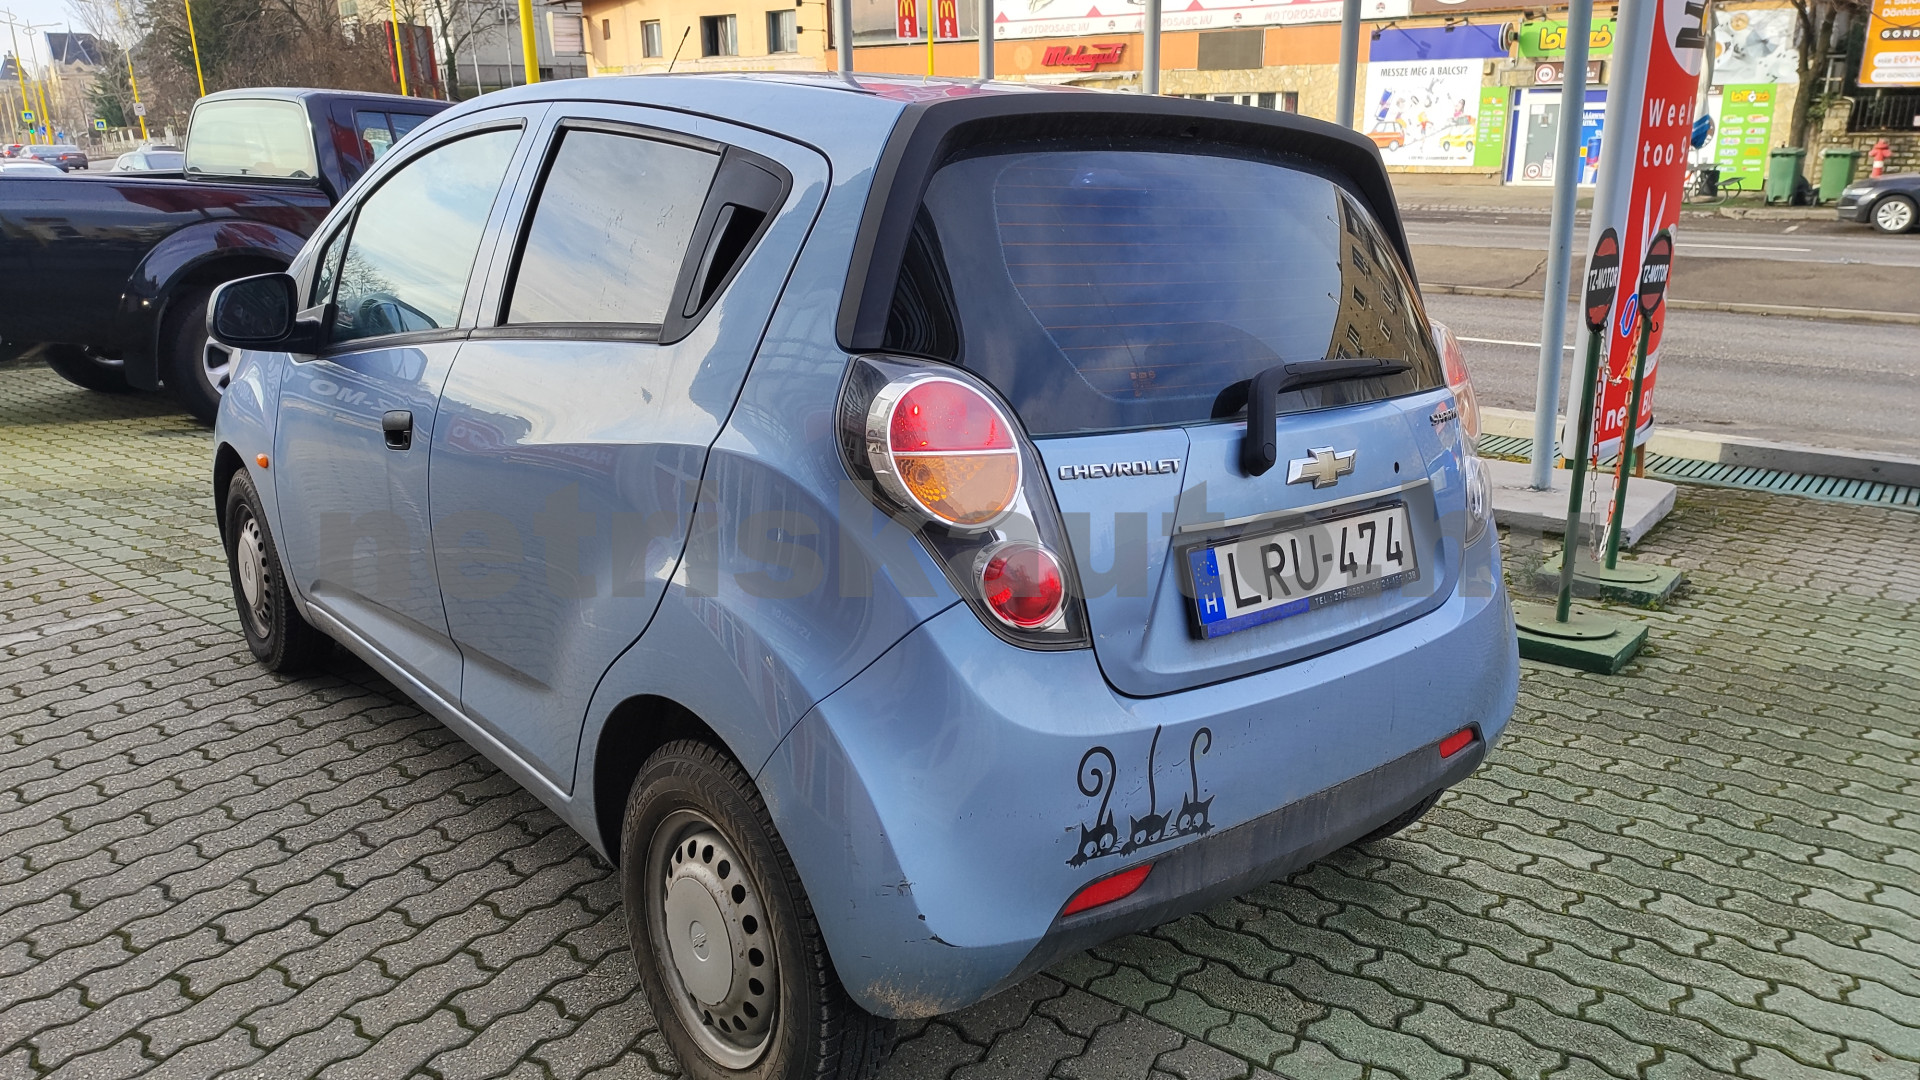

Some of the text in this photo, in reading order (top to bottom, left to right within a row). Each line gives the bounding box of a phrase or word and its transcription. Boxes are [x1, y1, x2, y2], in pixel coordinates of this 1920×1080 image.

[1380, 65, 1468, 77] MESSZE MÉG A BALCSI?
[1588, 266, 1619, 292] TZ-MOTOR
[1058, 457, 1182, 481] CHEVROLET
[1227, 516, 1404, 610] LRU-474
[1203, 592, 1219, 615] H
